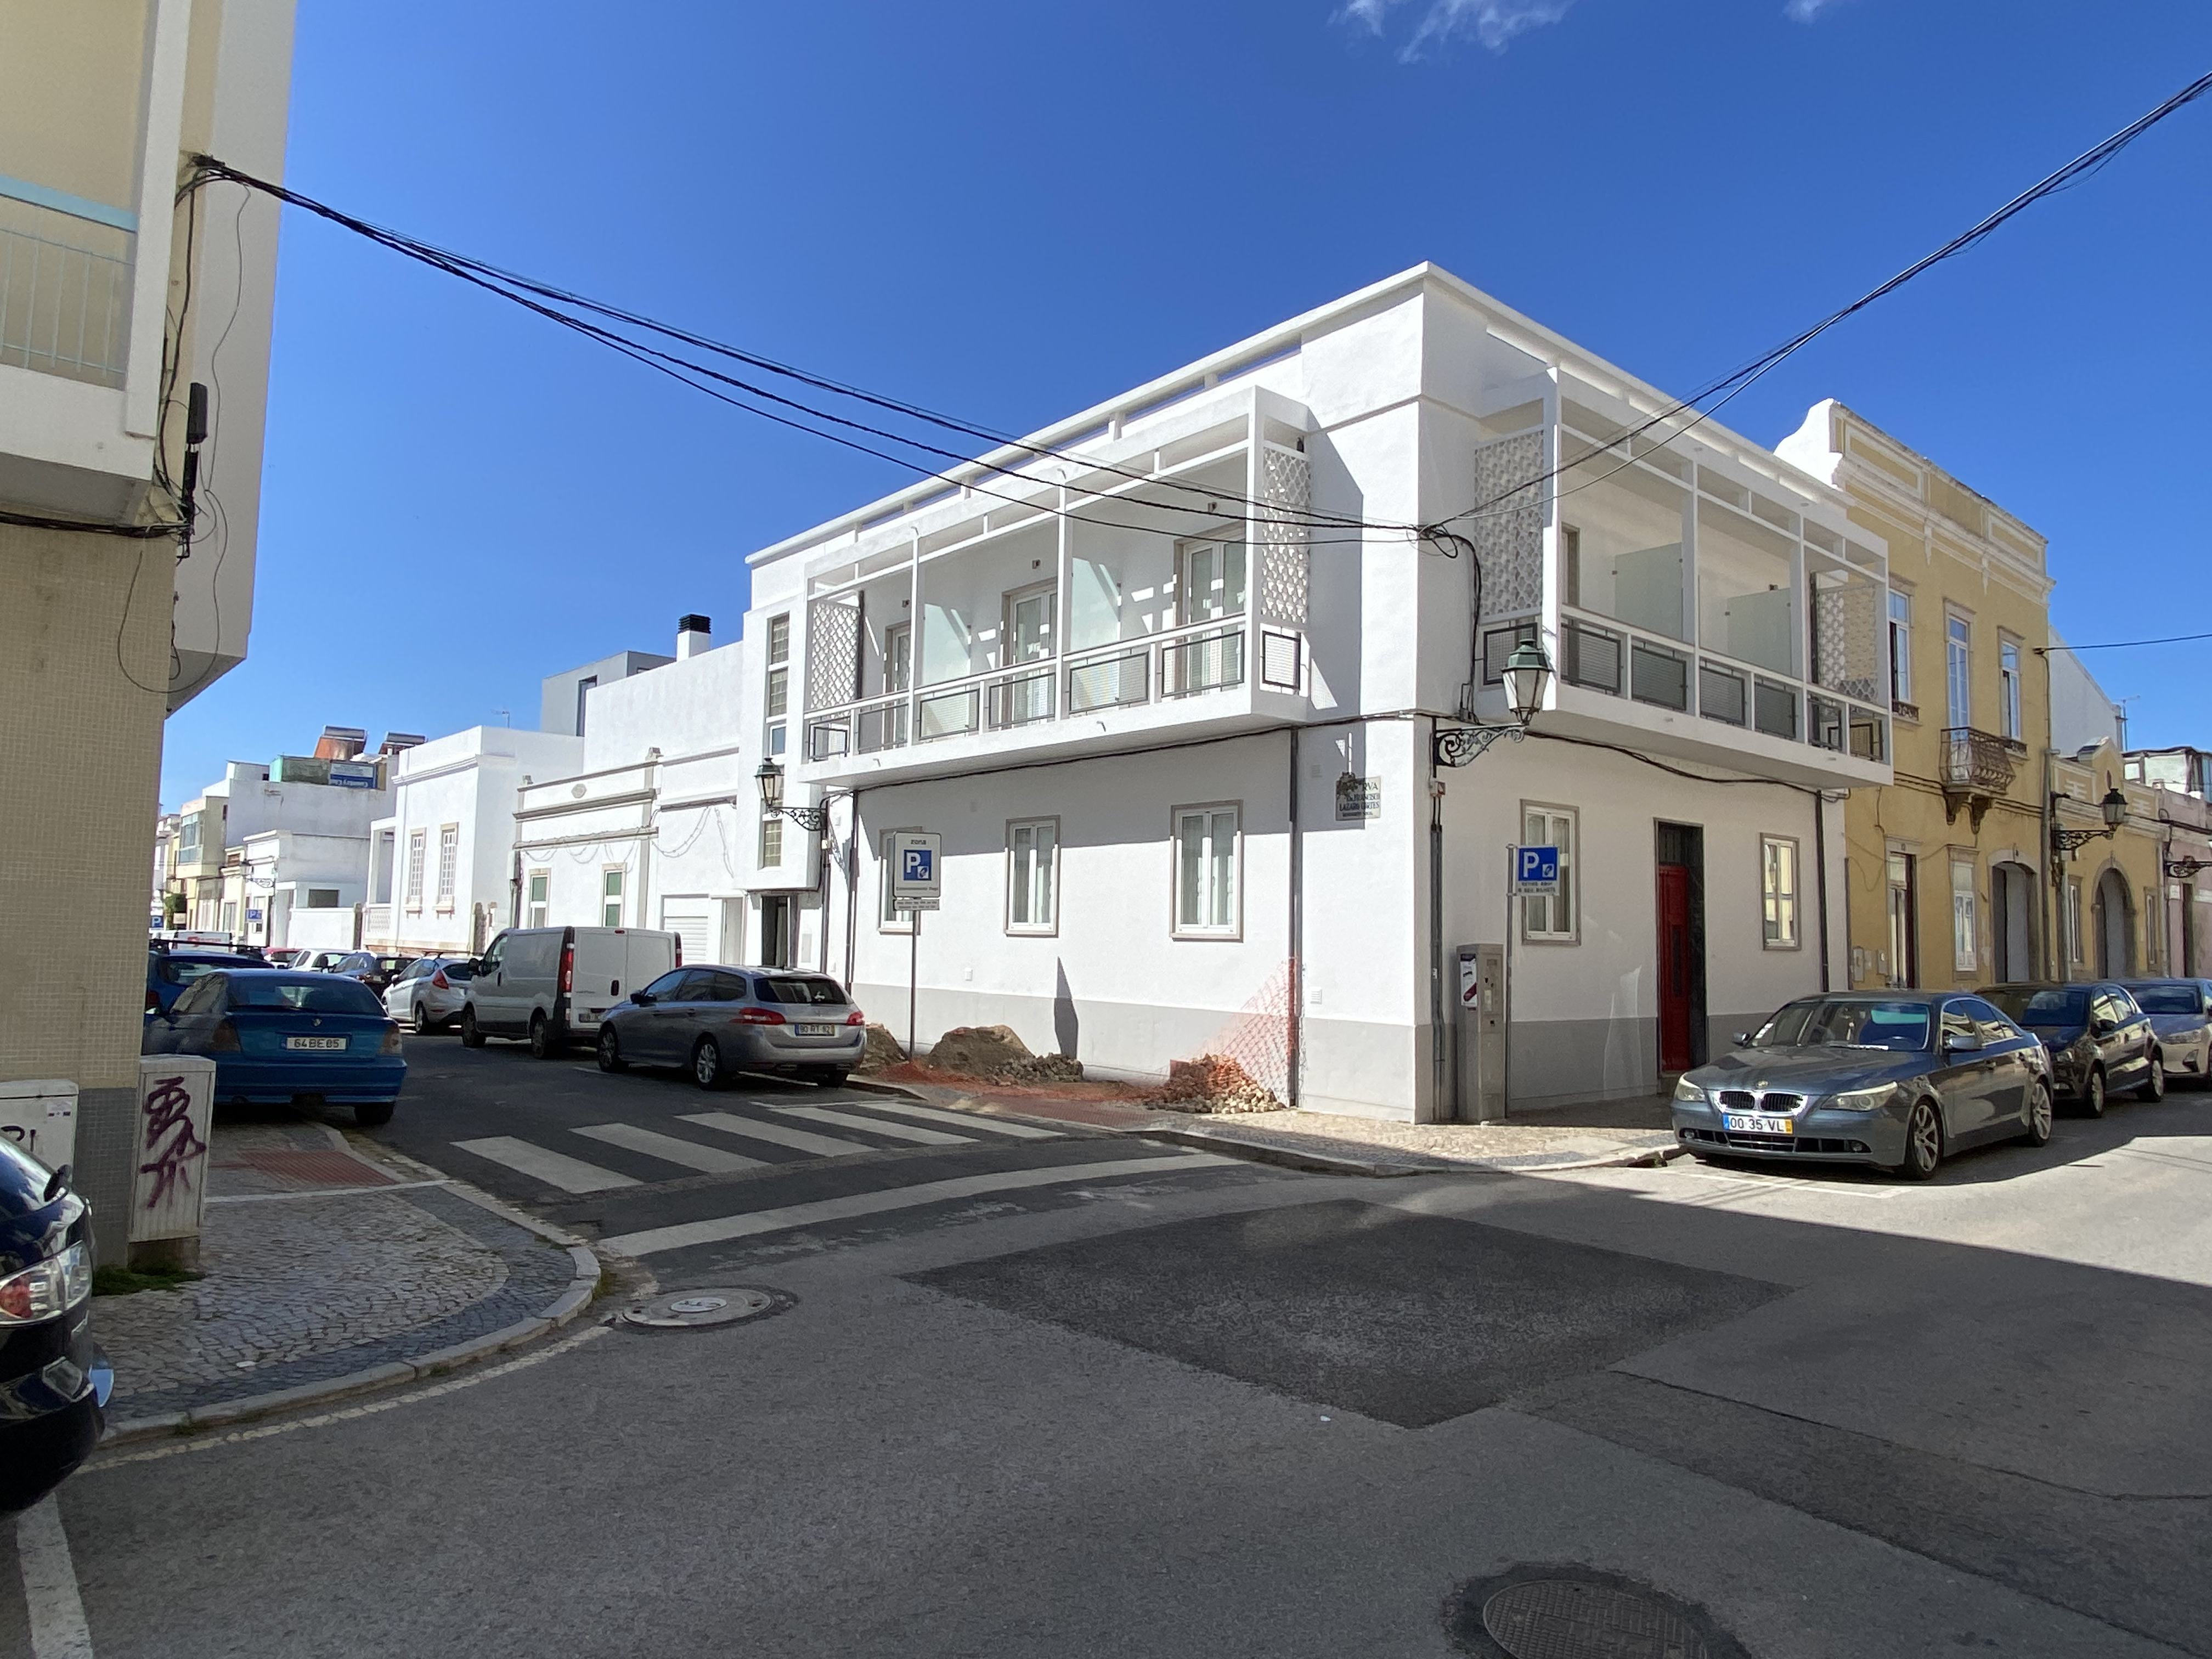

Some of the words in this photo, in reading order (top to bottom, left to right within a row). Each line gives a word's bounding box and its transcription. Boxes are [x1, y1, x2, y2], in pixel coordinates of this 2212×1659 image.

[1363, 782, 1378, 791] RVA
[906, 852, 921, 873] P
[1523, 851, 1539, 878] P
[151, 916, 161, 928] P
[1730, 1118, 1744, 1128] 00
[1748, 1118, 1763, 1130] 35
[1768, 1120, 1784, 1132] VL
